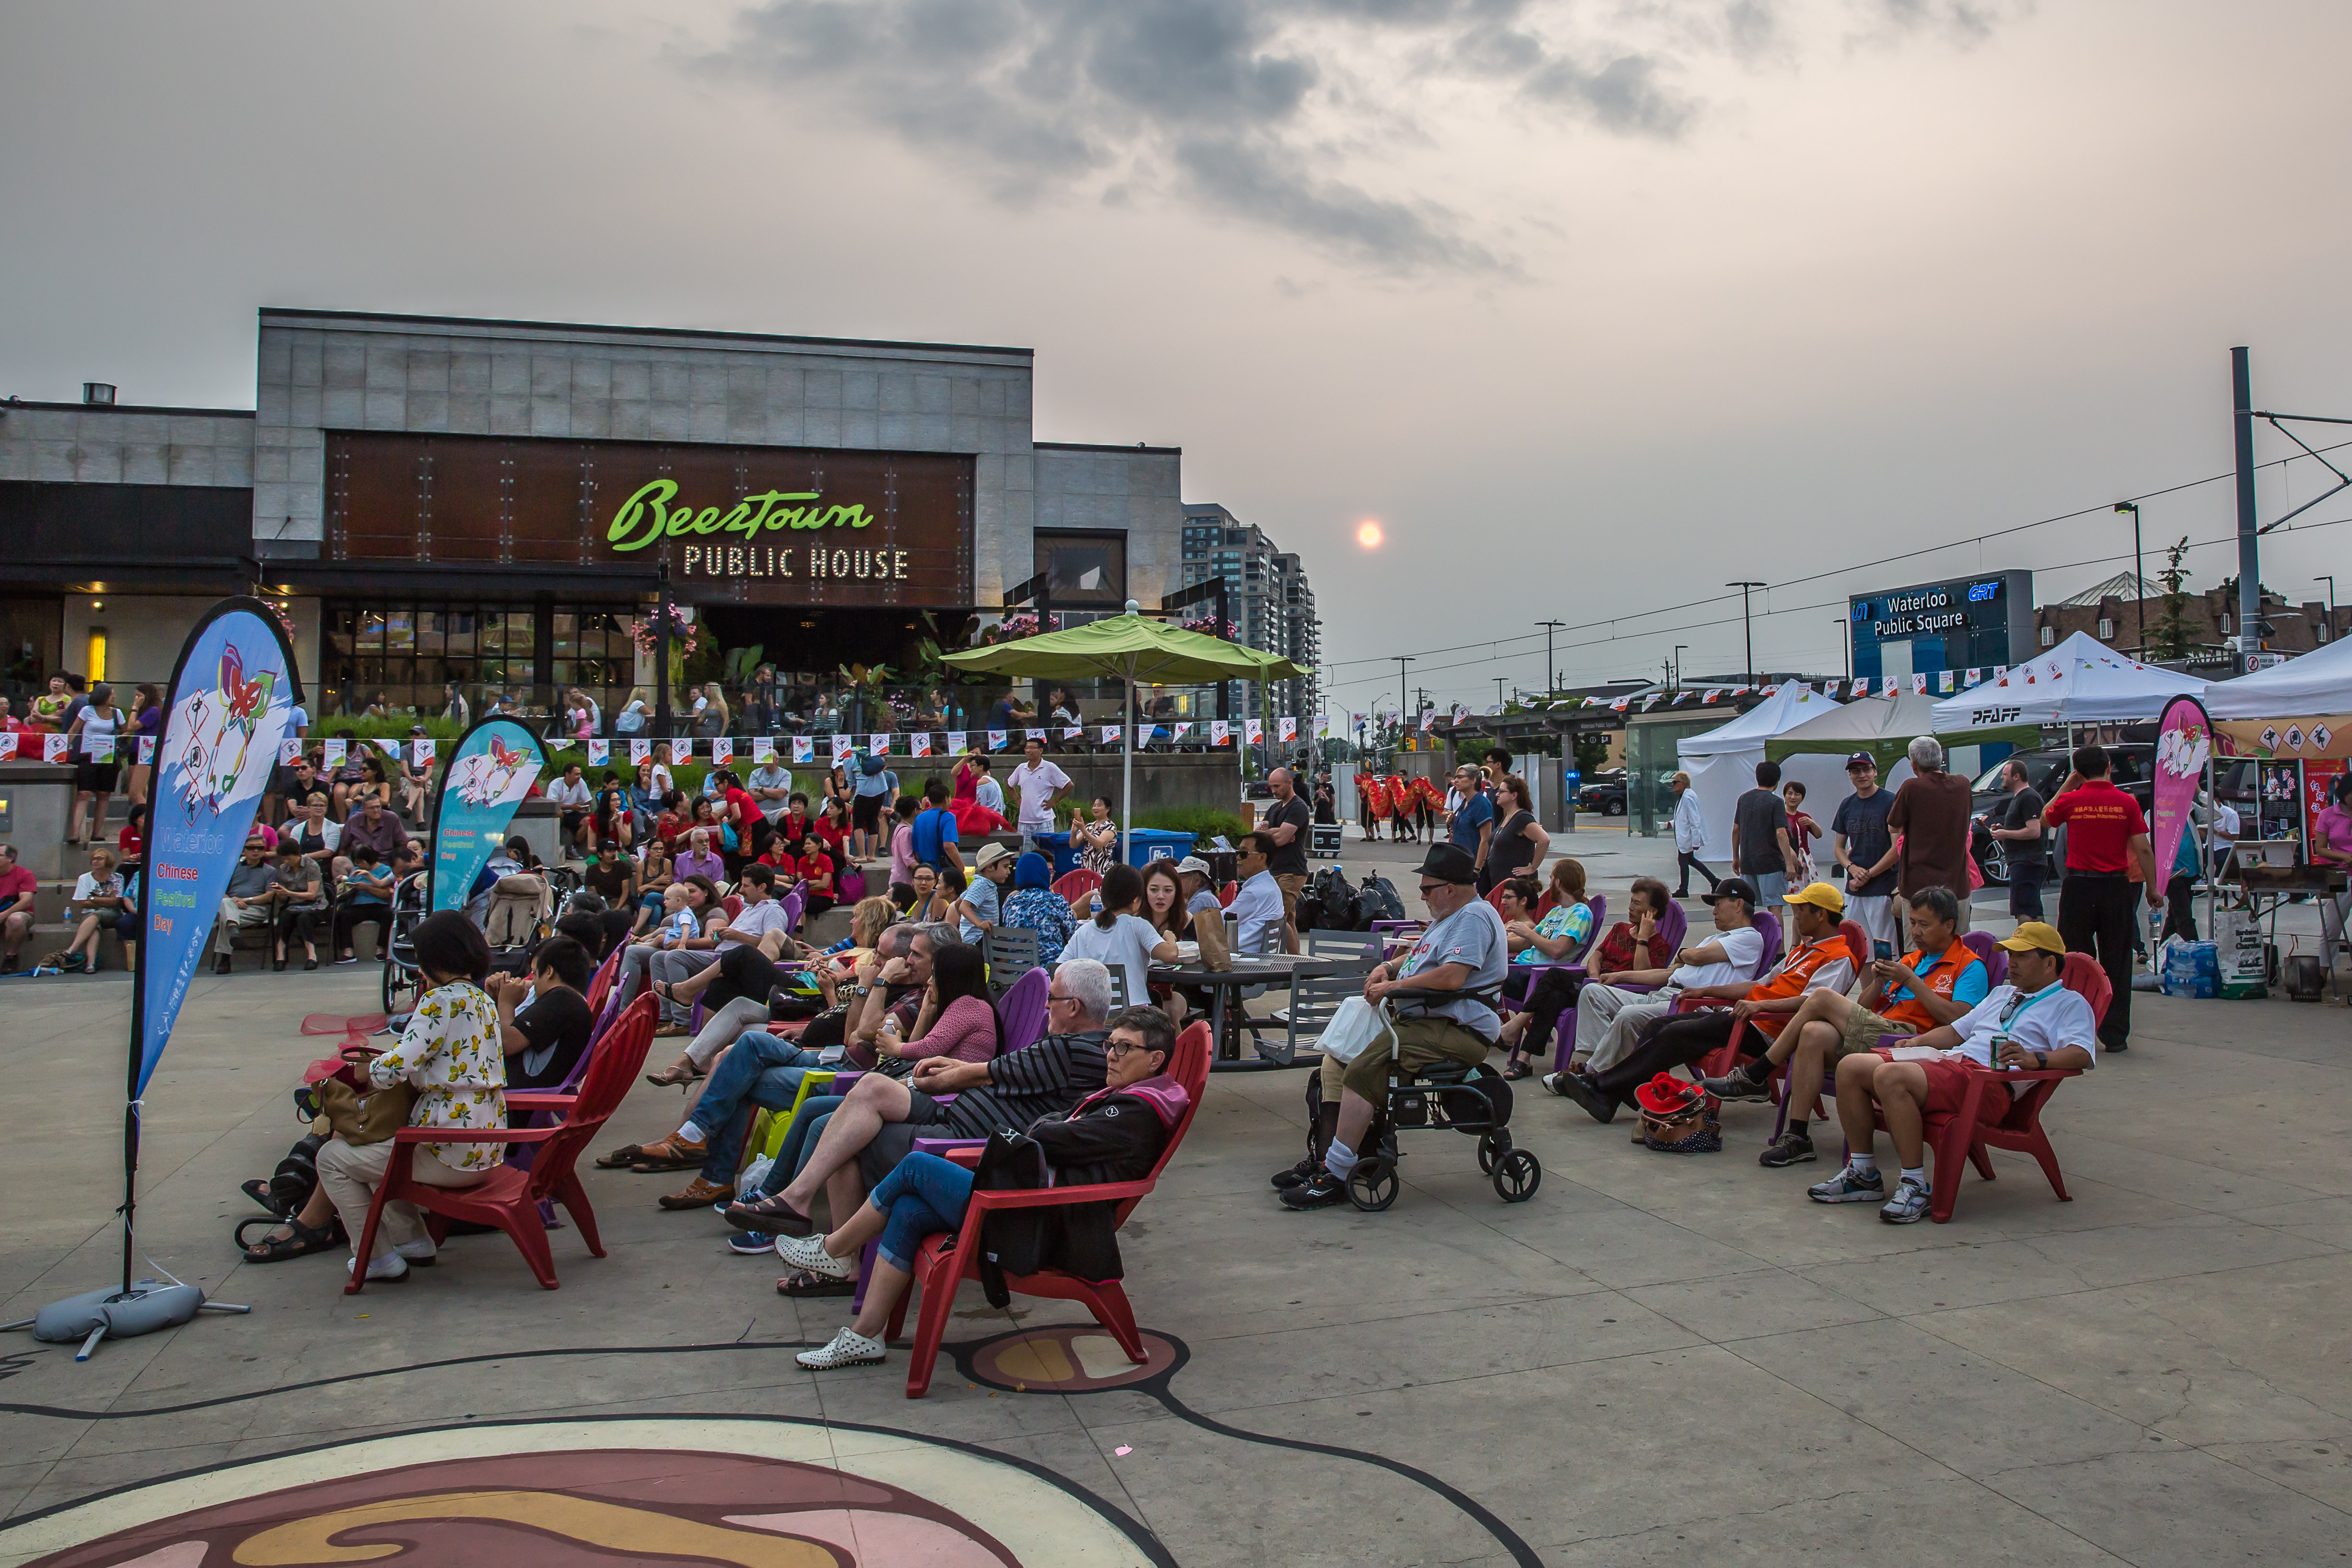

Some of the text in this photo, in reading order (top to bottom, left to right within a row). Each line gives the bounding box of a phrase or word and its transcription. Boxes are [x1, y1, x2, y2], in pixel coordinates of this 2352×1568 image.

[607, 478, 874, 551] Beertown
[684, 546, 909, 579] PUBLIC HOUSE
[1887, 592, 1947, 613] Waterloo
[1968, 582, 1999, 602] GRT
[1875, 613, 1963, 636] Public Square
[1972, 707, 2021, 724] PFAFF
[161, 827, 224, 854] Waterloo
[441, 852, 456, 861] Day
[157, 862, 198, 881] Chinese
[155, 889, 197, 908] Festival
[154, 914, 174, 935] Day
